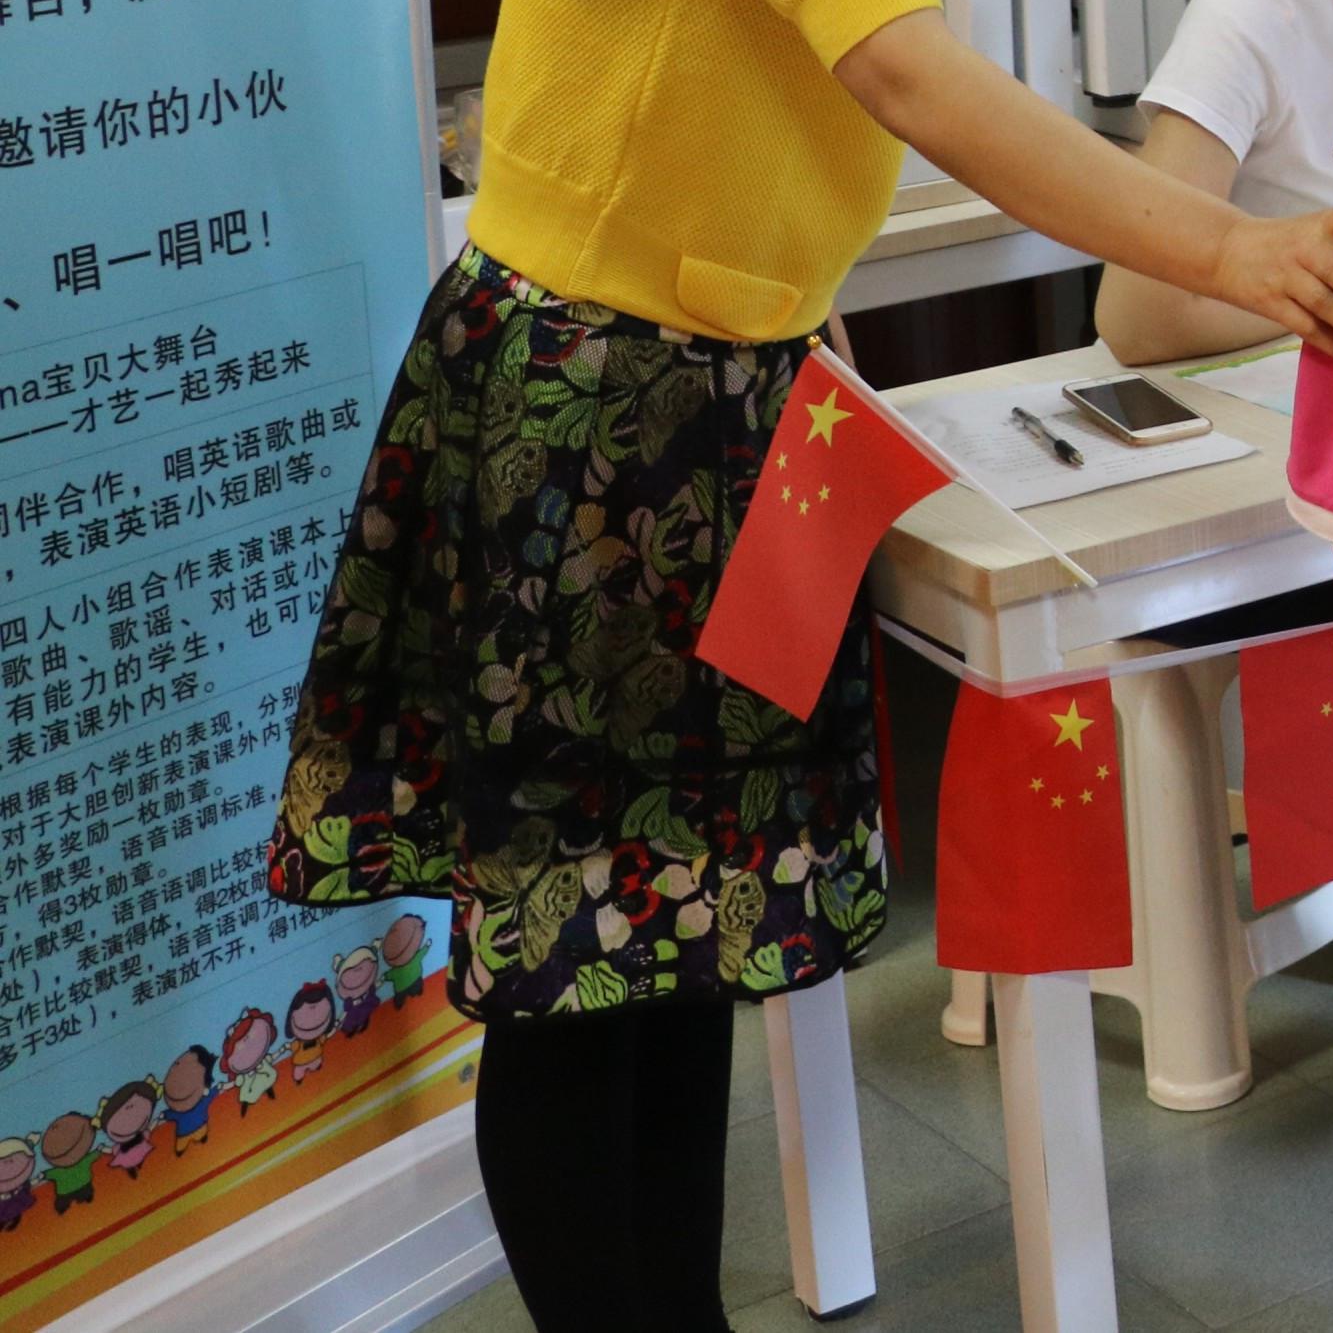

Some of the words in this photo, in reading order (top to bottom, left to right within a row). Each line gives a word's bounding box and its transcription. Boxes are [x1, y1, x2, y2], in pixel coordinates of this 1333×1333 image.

[0, 68, 288, 168] 邀请你的小伙
[0, 507, 354, 652] 四人小组合作表演课本上
[1, 542, 345, 689] 歌曲、歌谣、对话或小
[0, 860, 168, 946] ，得3枚勋章。
[0, 837, 272, 979] 作默契，语音语调比较
[0, 896, 289, 1038] 合作比较默契，语音语调方
